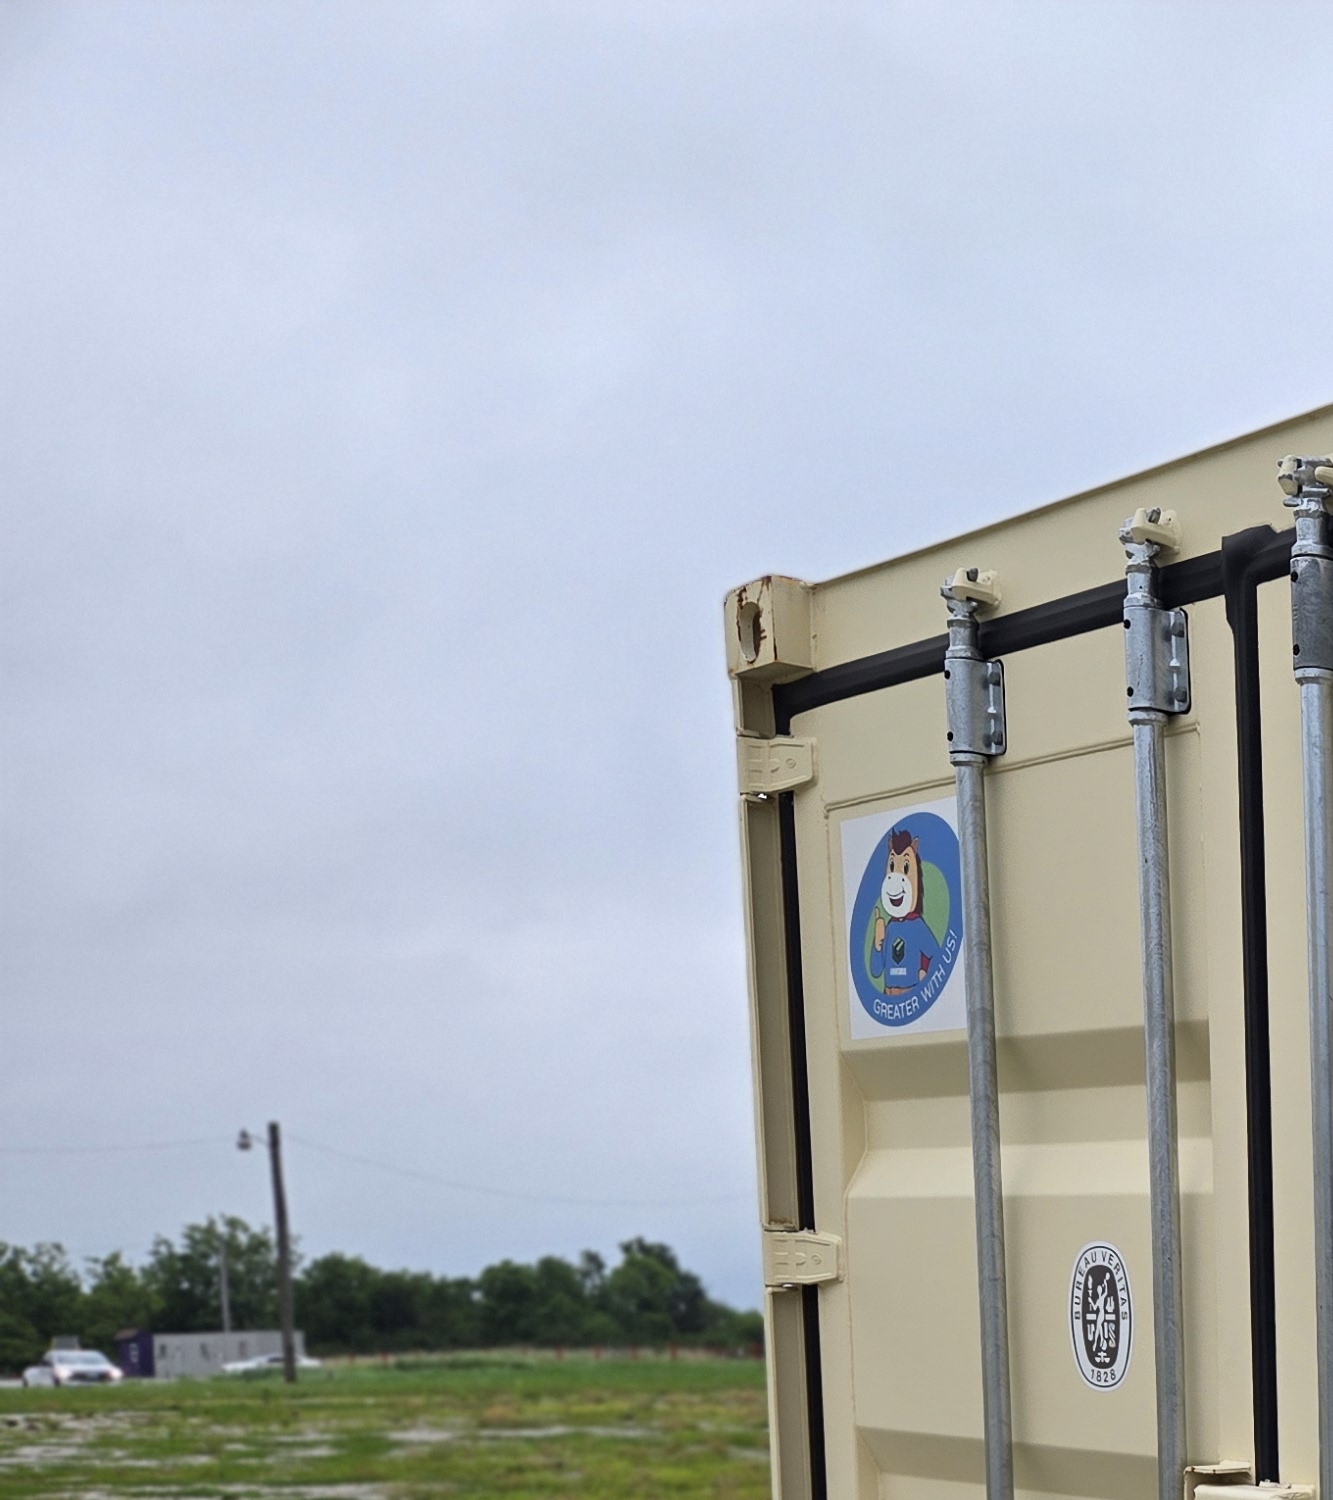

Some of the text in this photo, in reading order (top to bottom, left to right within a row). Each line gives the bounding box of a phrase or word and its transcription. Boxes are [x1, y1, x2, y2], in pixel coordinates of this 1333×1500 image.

[873, 996, 920, 1021] GREATER
[921, 964, 946, 1002] WITH
[942, 928, 958, 964] US!
[1074, 1250, 1129, 1321] BUREAU VERITAS
[1090, 1368, 1117, 1383] 1828
